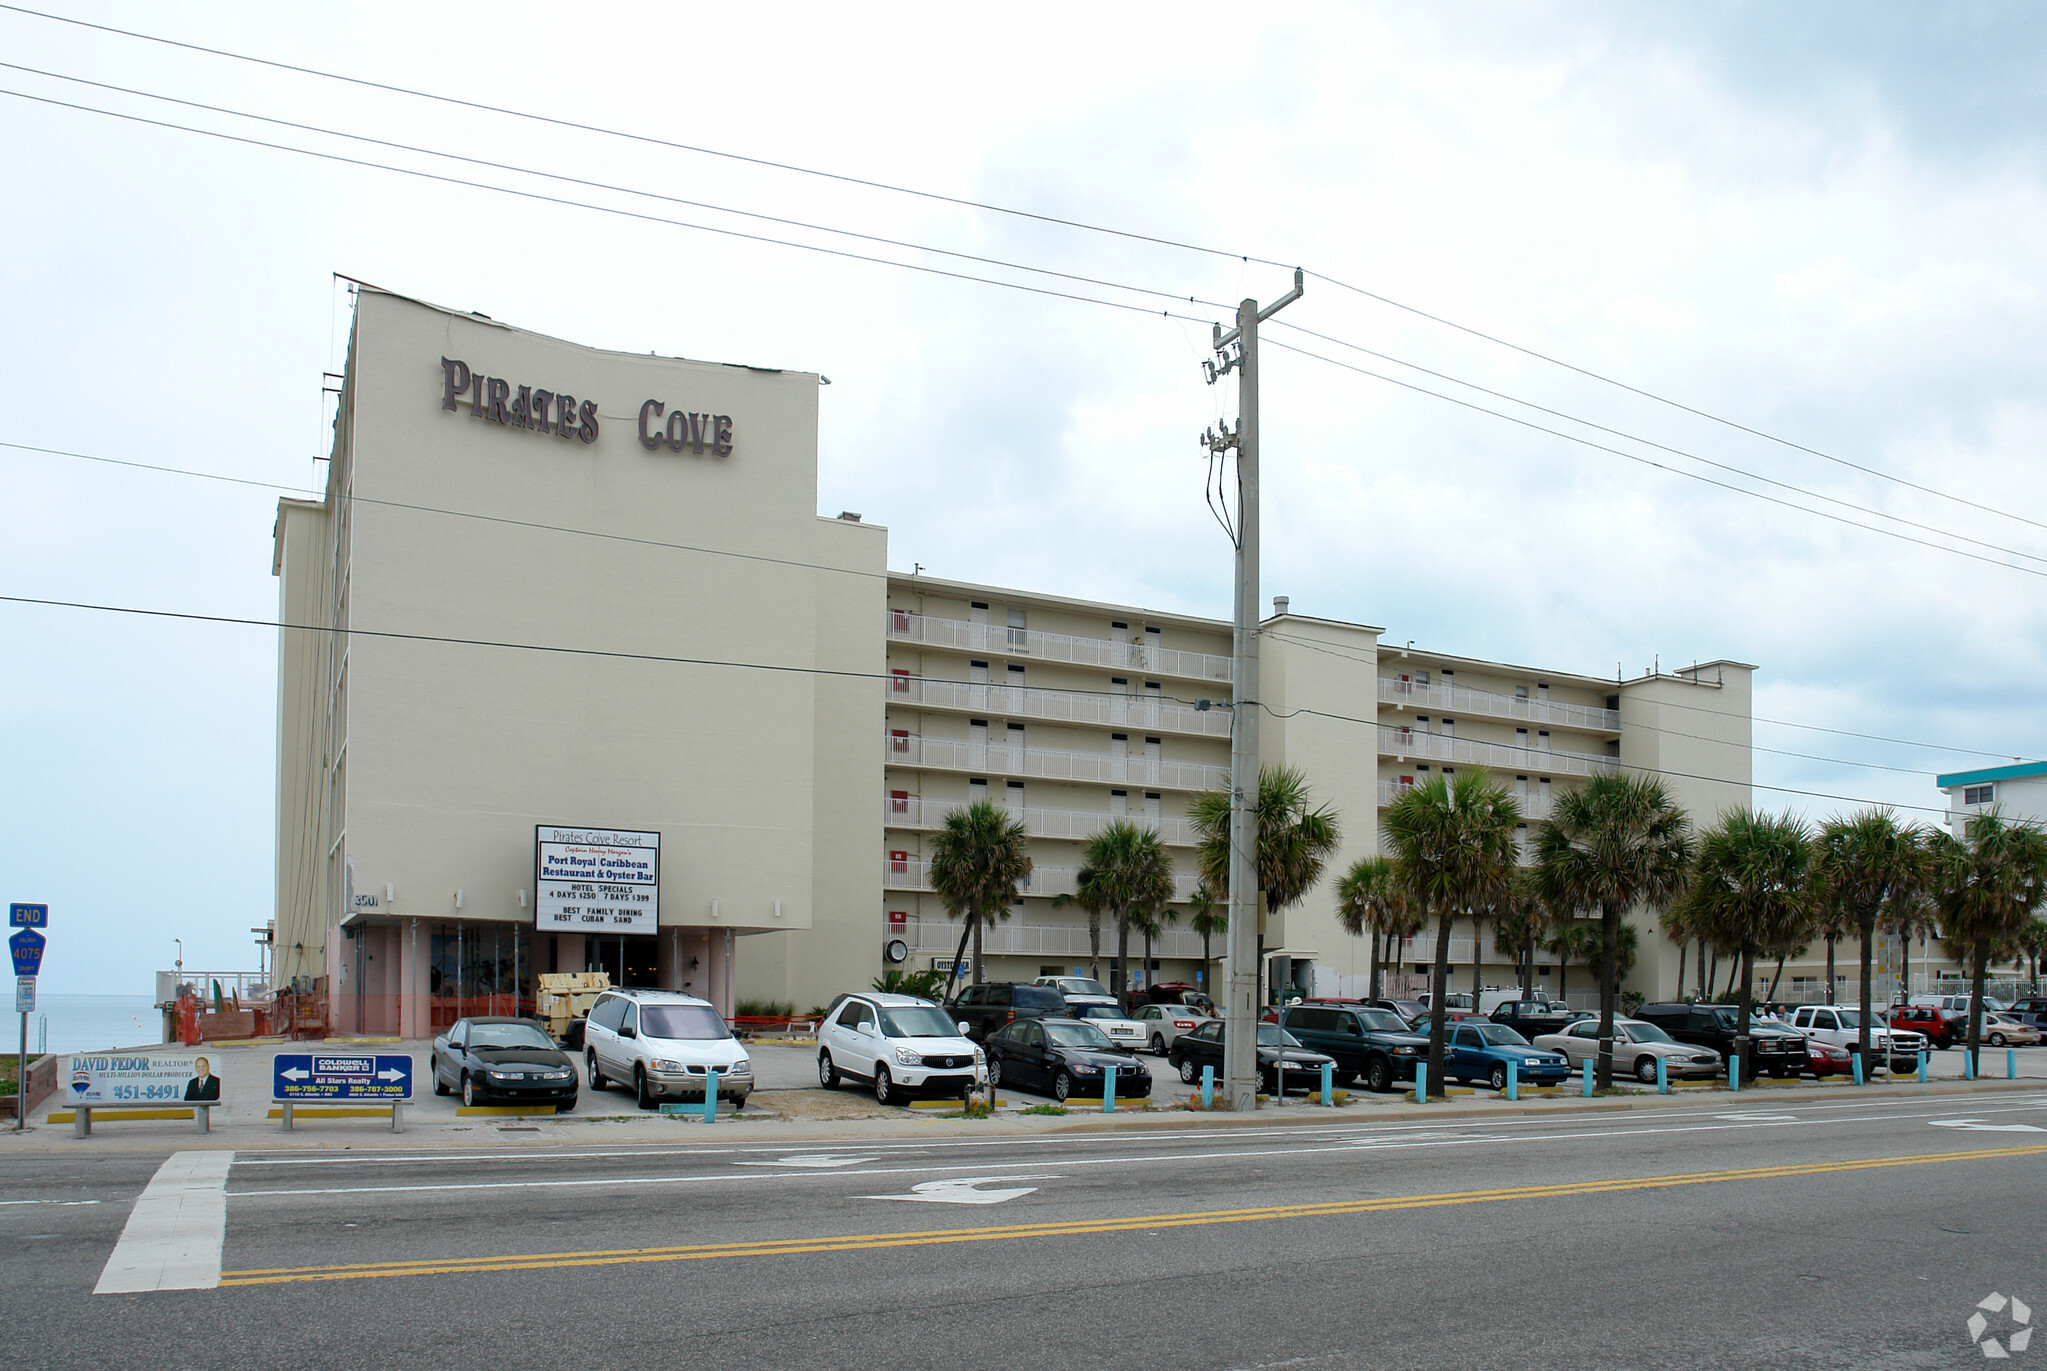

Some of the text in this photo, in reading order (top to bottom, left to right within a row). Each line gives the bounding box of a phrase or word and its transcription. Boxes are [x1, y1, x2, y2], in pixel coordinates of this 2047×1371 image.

[441, 355, 733, 457] PIRATES COVE
[553, 830, 642, 846] Pirates Cove Resort
[565, 846, 632, 857] Captain Henry Morgan's
[548, 855, 649, 869] Port Royal Caribbean
[542, 867, 653, 881] Restaurant & Oyster Bar
[571, 884, 633, 894] HOTEL SPECIALS
[355, 895, 378, 907] 3501
[557, 891, 576, 899] DAYS
[579, 892, 597, 900] $250
[610, 893, 630, 901] DAYS
[16, 908, 41, 923] END
[563, 906, 643, 917] BEST FAMILY DINING
[613, 916, 632, 924] SAND
[13, 947, 41, 960] 4075
[936, 960, 954, 970] OYSTE
[72, 1056, 109, 1071] DAVID
[110, 1056, 150, 1071] FEDOR
[315, 1077, 326, 1085] All
[347, 1078, 371, 1086] Realty
[284, 1085, 339, 1093] 386-756-7703
[349, 1085, 403, 1093] 386-767-3000
